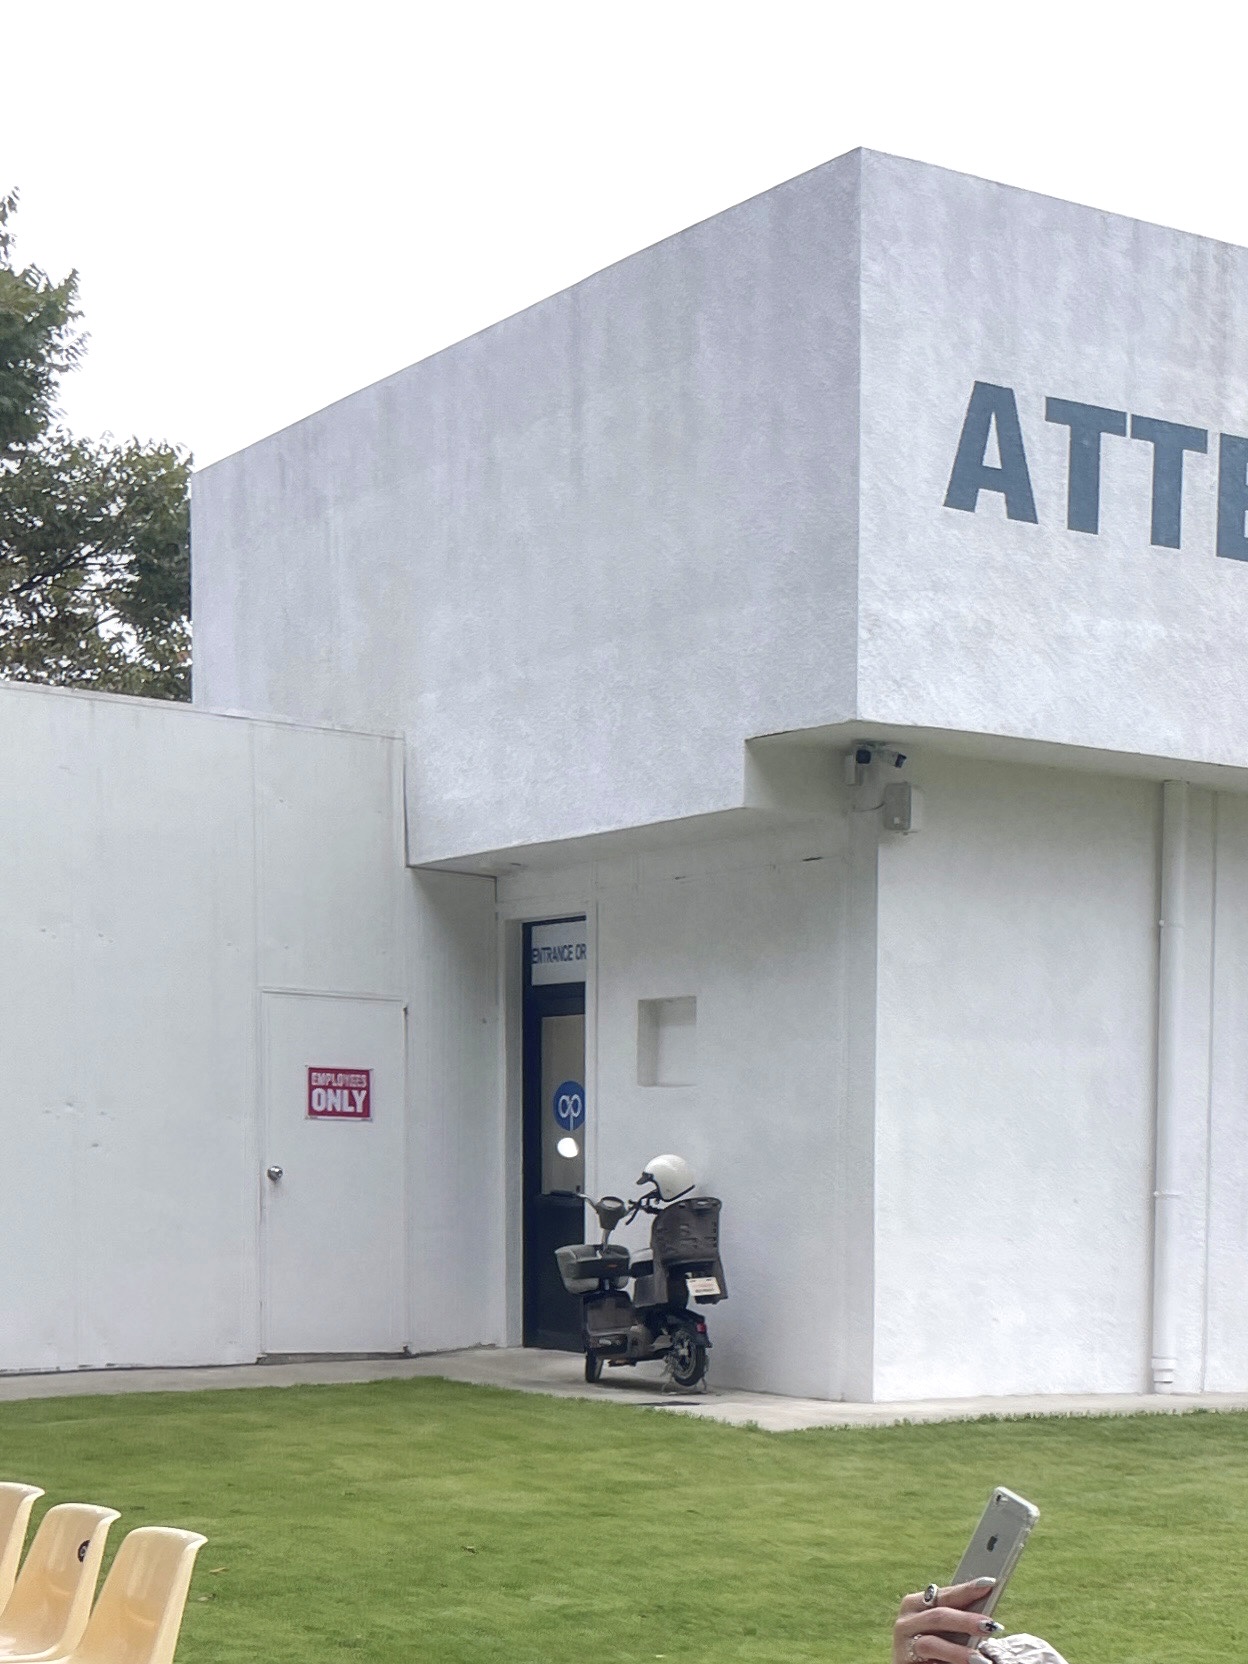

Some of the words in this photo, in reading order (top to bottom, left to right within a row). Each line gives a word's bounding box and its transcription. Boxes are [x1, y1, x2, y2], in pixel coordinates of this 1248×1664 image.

[532, 944, 574, 964] ENTRANCE
[575, 943, 587, 960] OR
[311, 1072, 367, 1088] EMPLOYEES
[311, 1087, 367, 1113] ONLY
